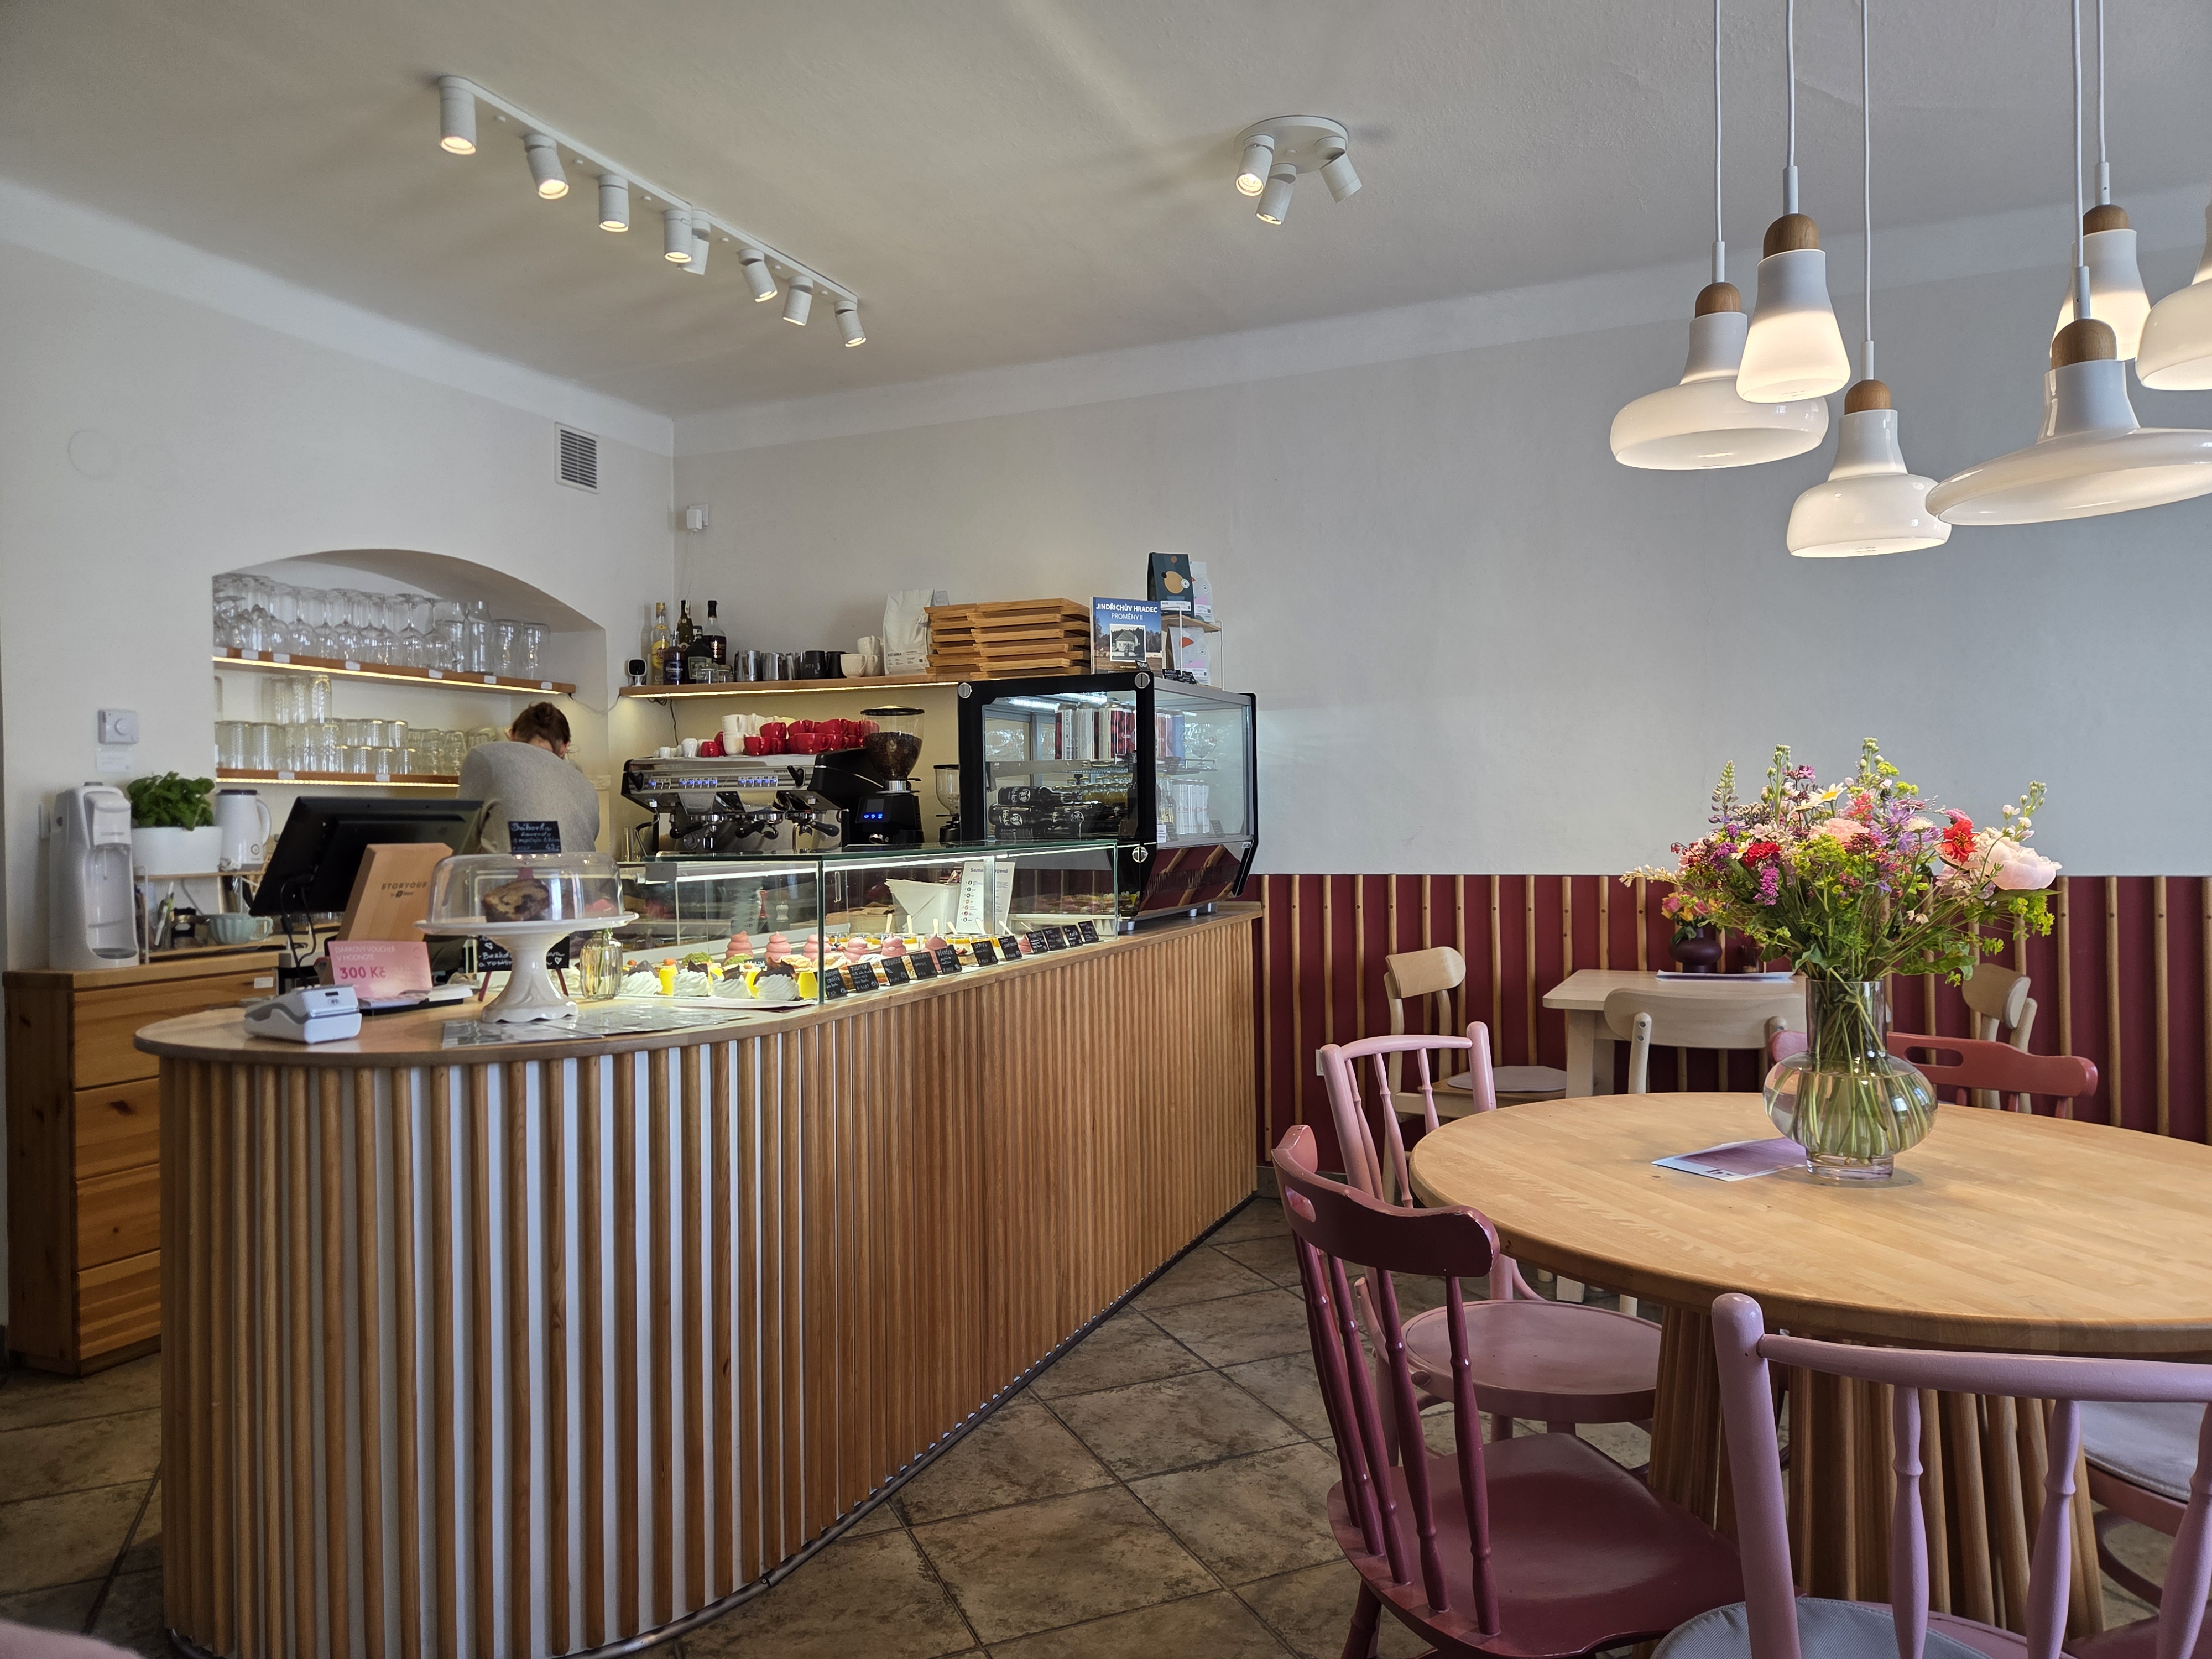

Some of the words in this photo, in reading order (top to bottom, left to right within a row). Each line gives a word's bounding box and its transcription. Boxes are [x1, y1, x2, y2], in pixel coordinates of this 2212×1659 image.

[1096, 603, 1132, 612] JINDŘICHŮV
[335, 946, 366, 954] DÁRKOVÝ
[340, 966, 366, 979] 300
[370, 966, 386, 978] Kč
